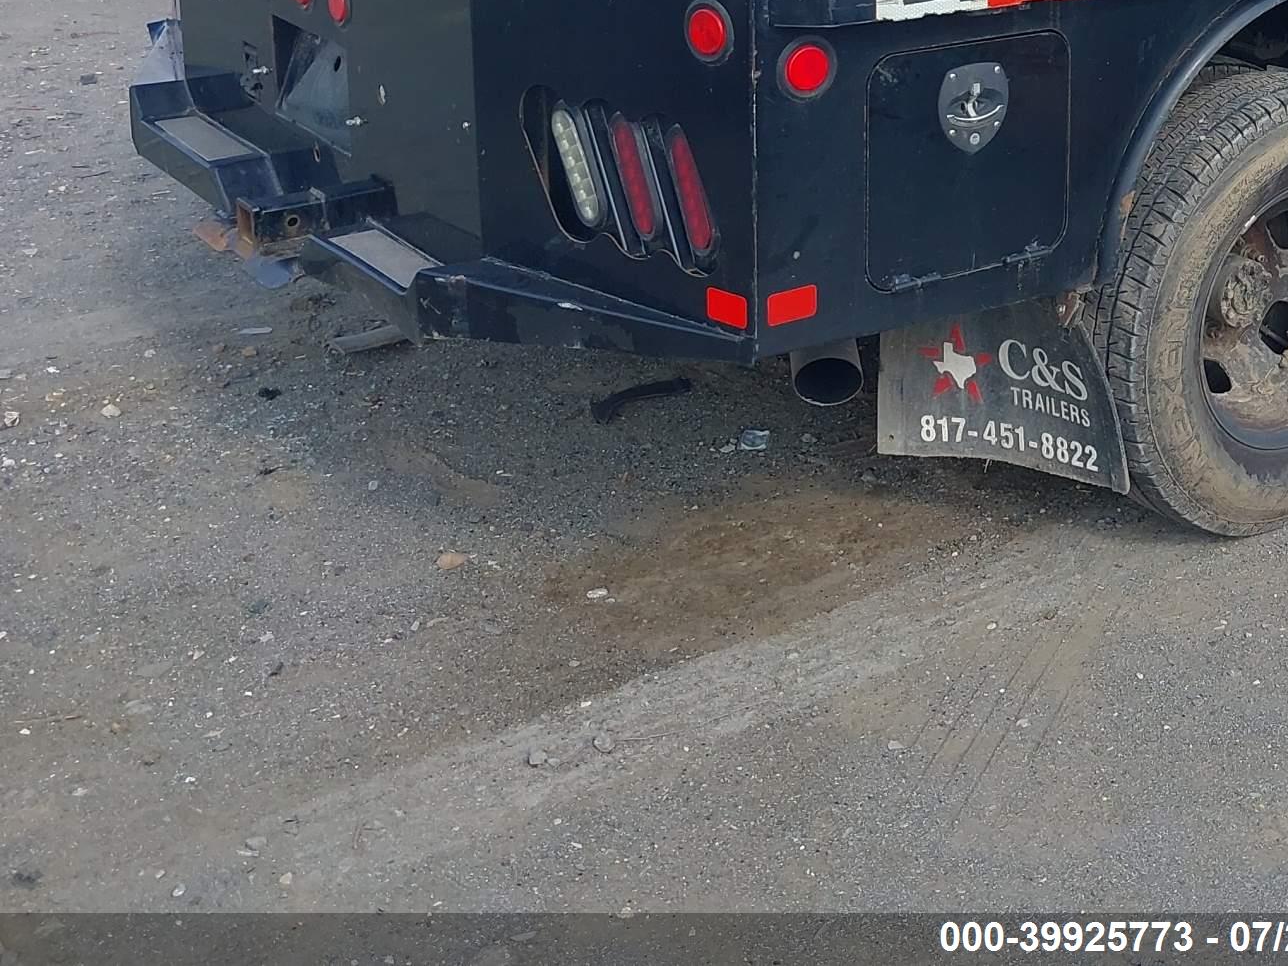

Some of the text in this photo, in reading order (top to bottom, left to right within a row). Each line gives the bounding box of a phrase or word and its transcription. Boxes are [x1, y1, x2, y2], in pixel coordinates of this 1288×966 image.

[998, 338, 1088, 401] C&S
[1010, 386, 1091, 427] TRAILERS
[920, 415, 1099, 472] 817-451-8822
